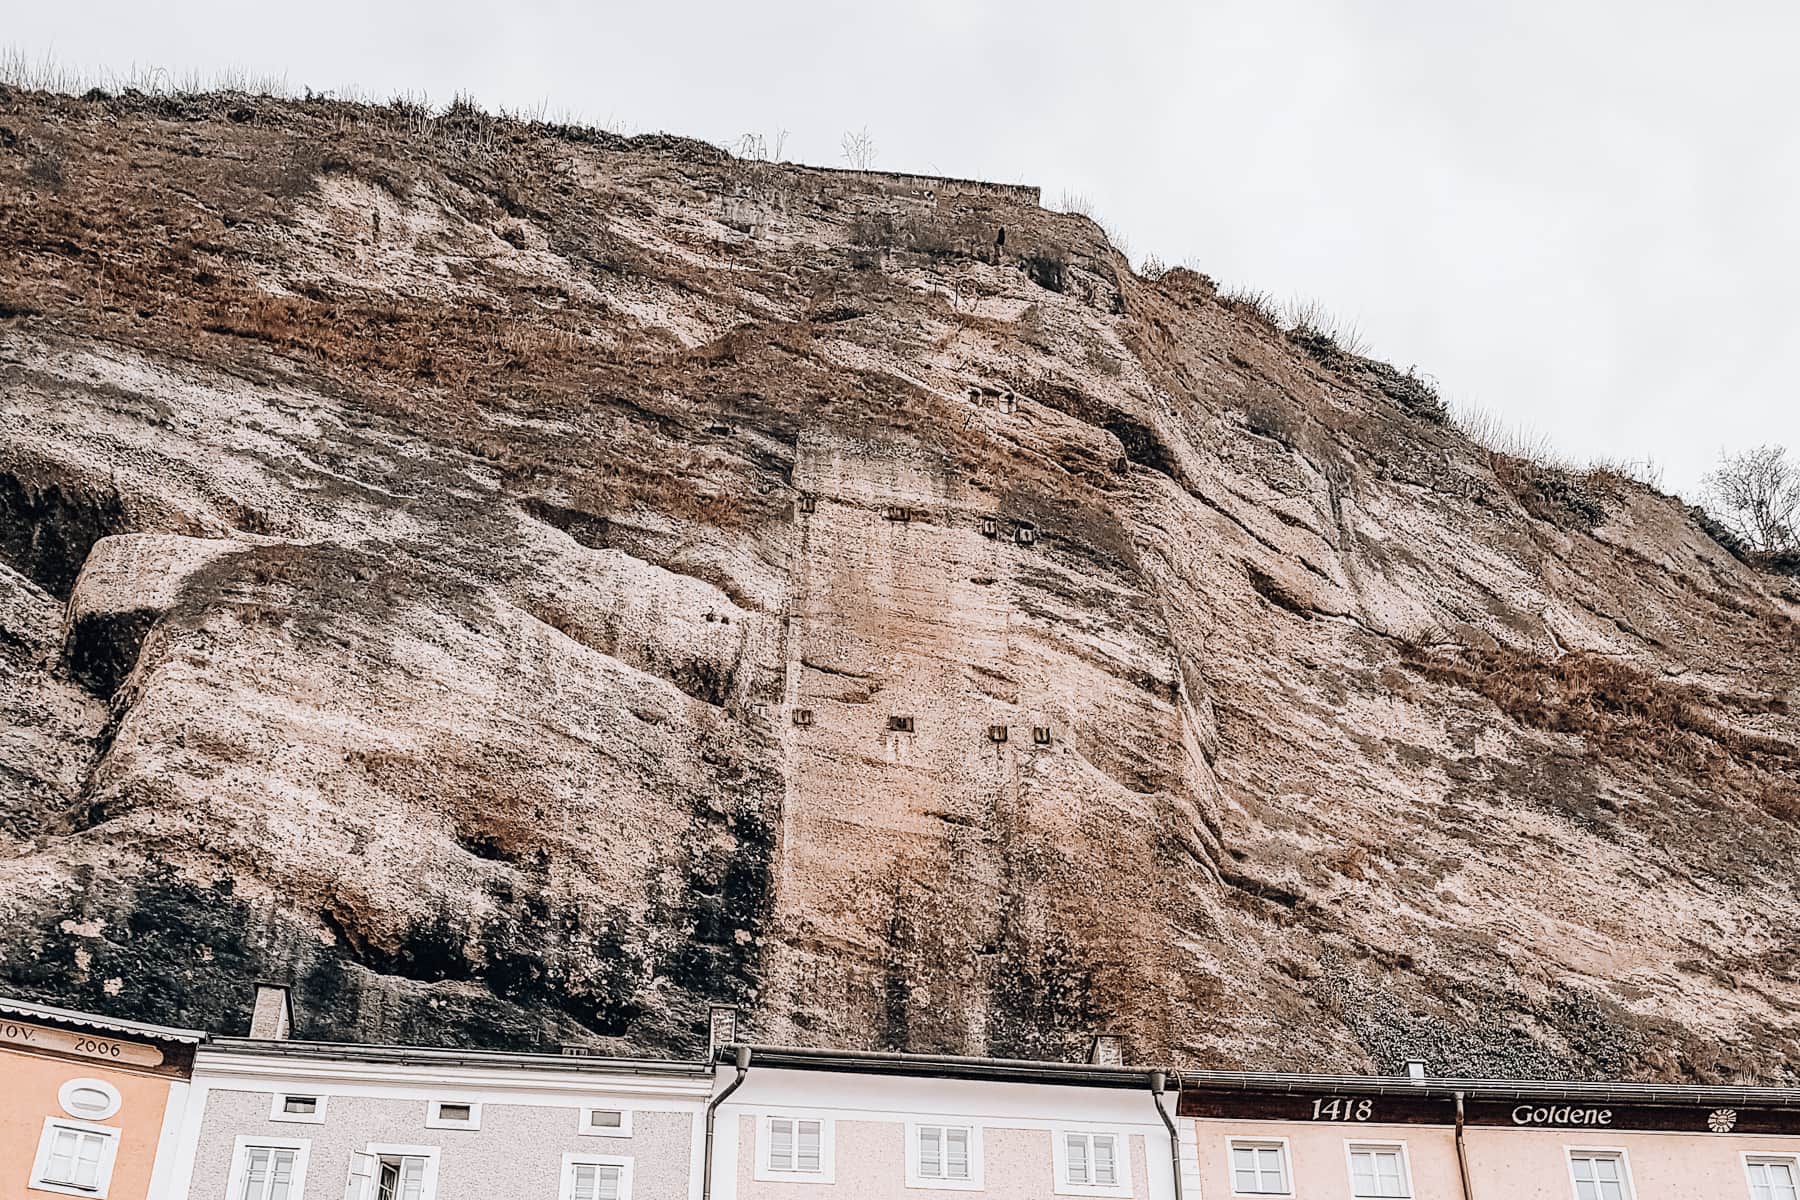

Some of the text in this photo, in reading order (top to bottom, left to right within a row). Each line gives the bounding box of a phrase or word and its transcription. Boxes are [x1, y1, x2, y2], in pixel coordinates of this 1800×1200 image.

[75, 1038, 120, 1057] 2006
[1312, 1098, 1373, 1121] 1418
[1512, 1105, 1612, 1126] Goldene
